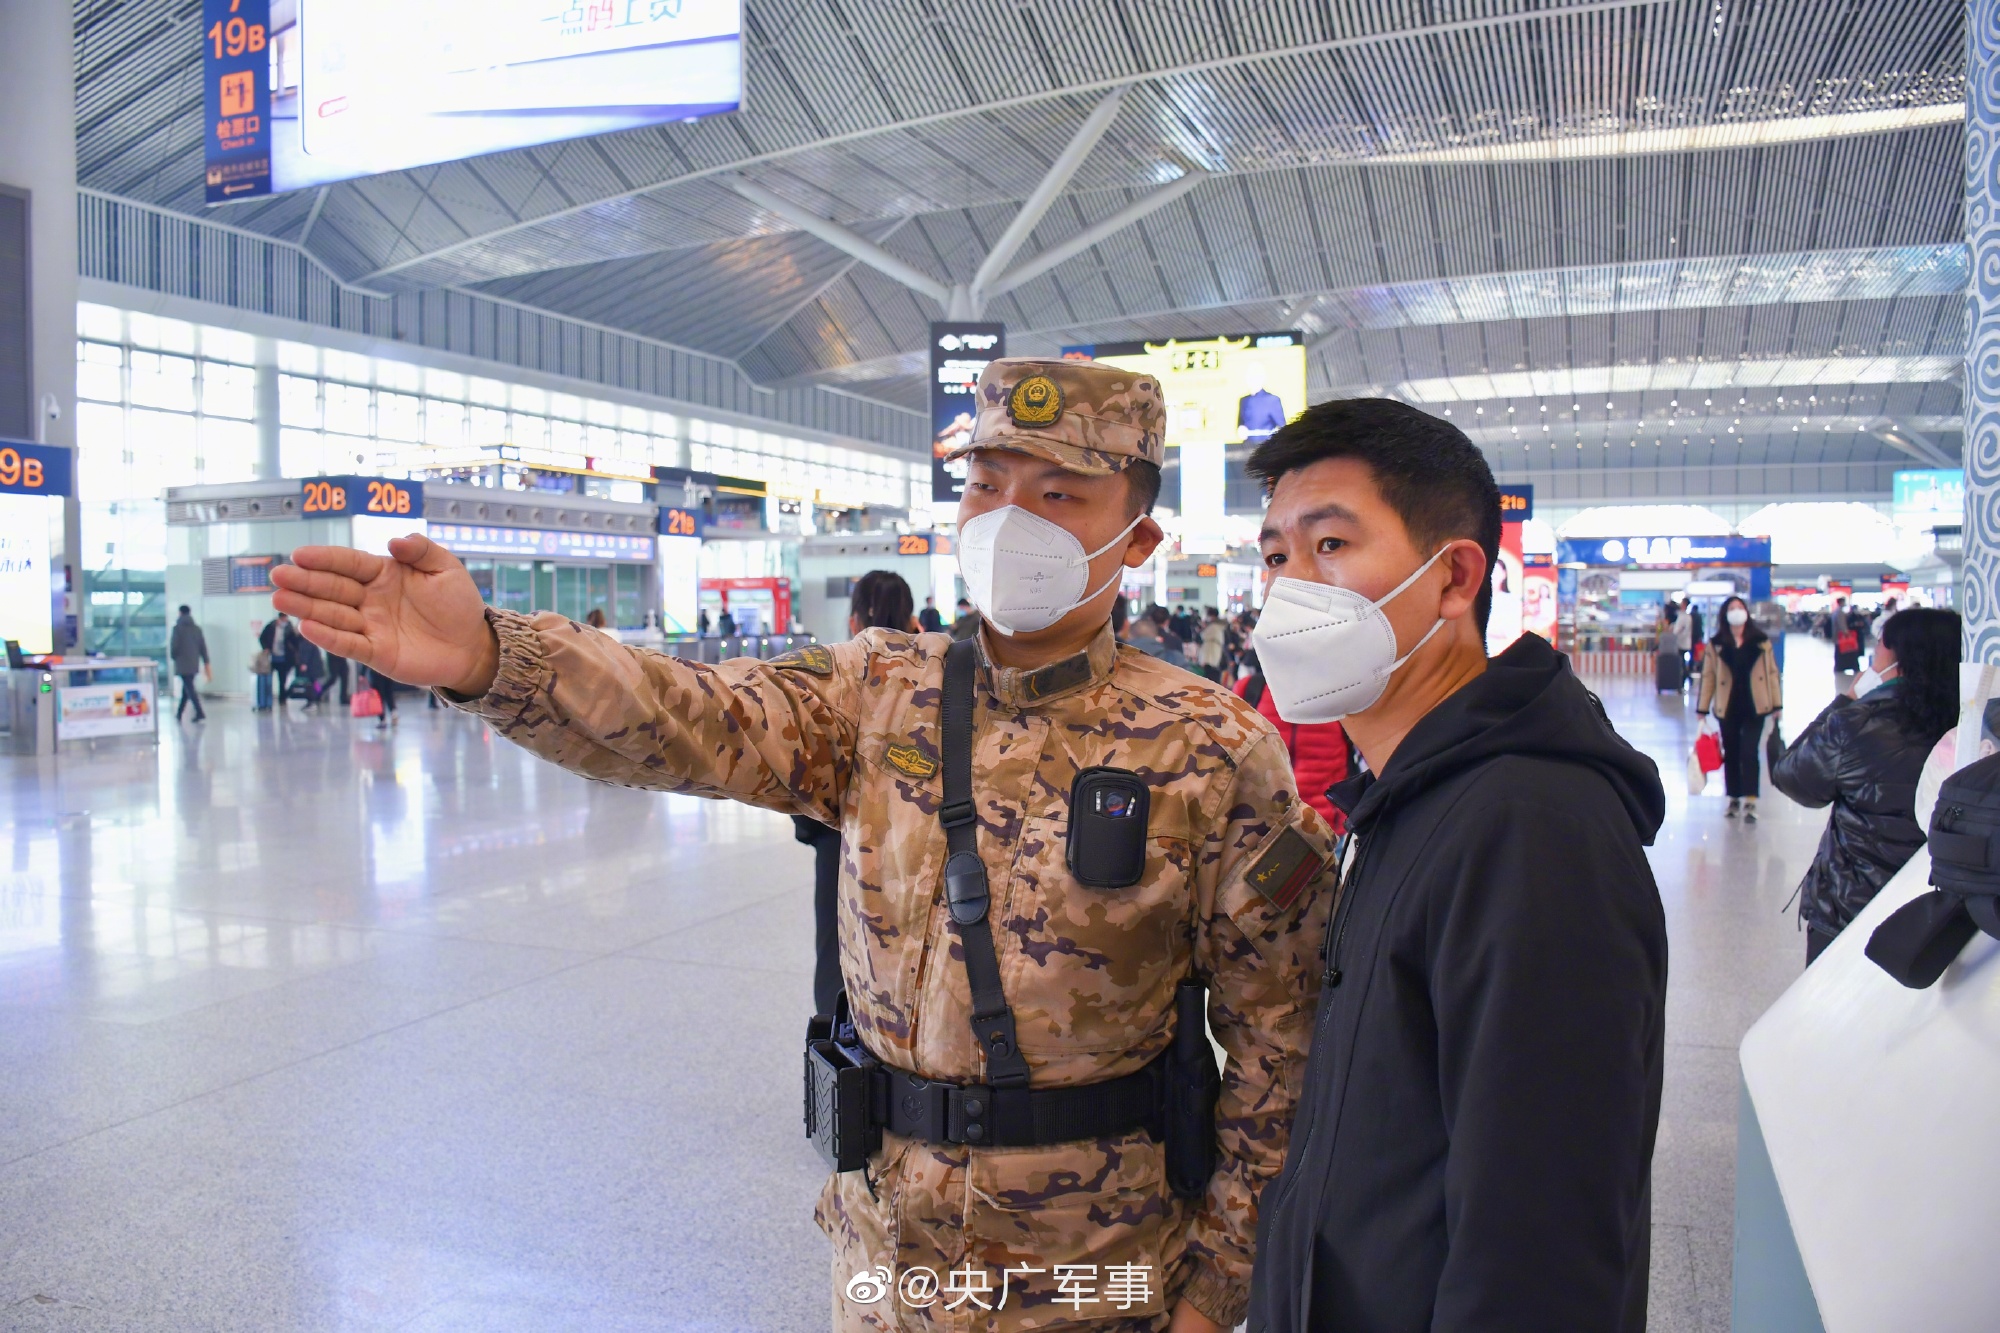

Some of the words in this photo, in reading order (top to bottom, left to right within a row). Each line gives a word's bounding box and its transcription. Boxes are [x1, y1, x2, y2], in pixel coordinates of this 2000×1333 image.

[208, 16, 267, 59] 19B
[216, 115, 260, 140] 检票口
[303, 481, 346, 512] 20B
[367, 481, 411, 514] 20B
[668, 508, 695, 535] 21B
[898, 535, 929, 555] 22B
